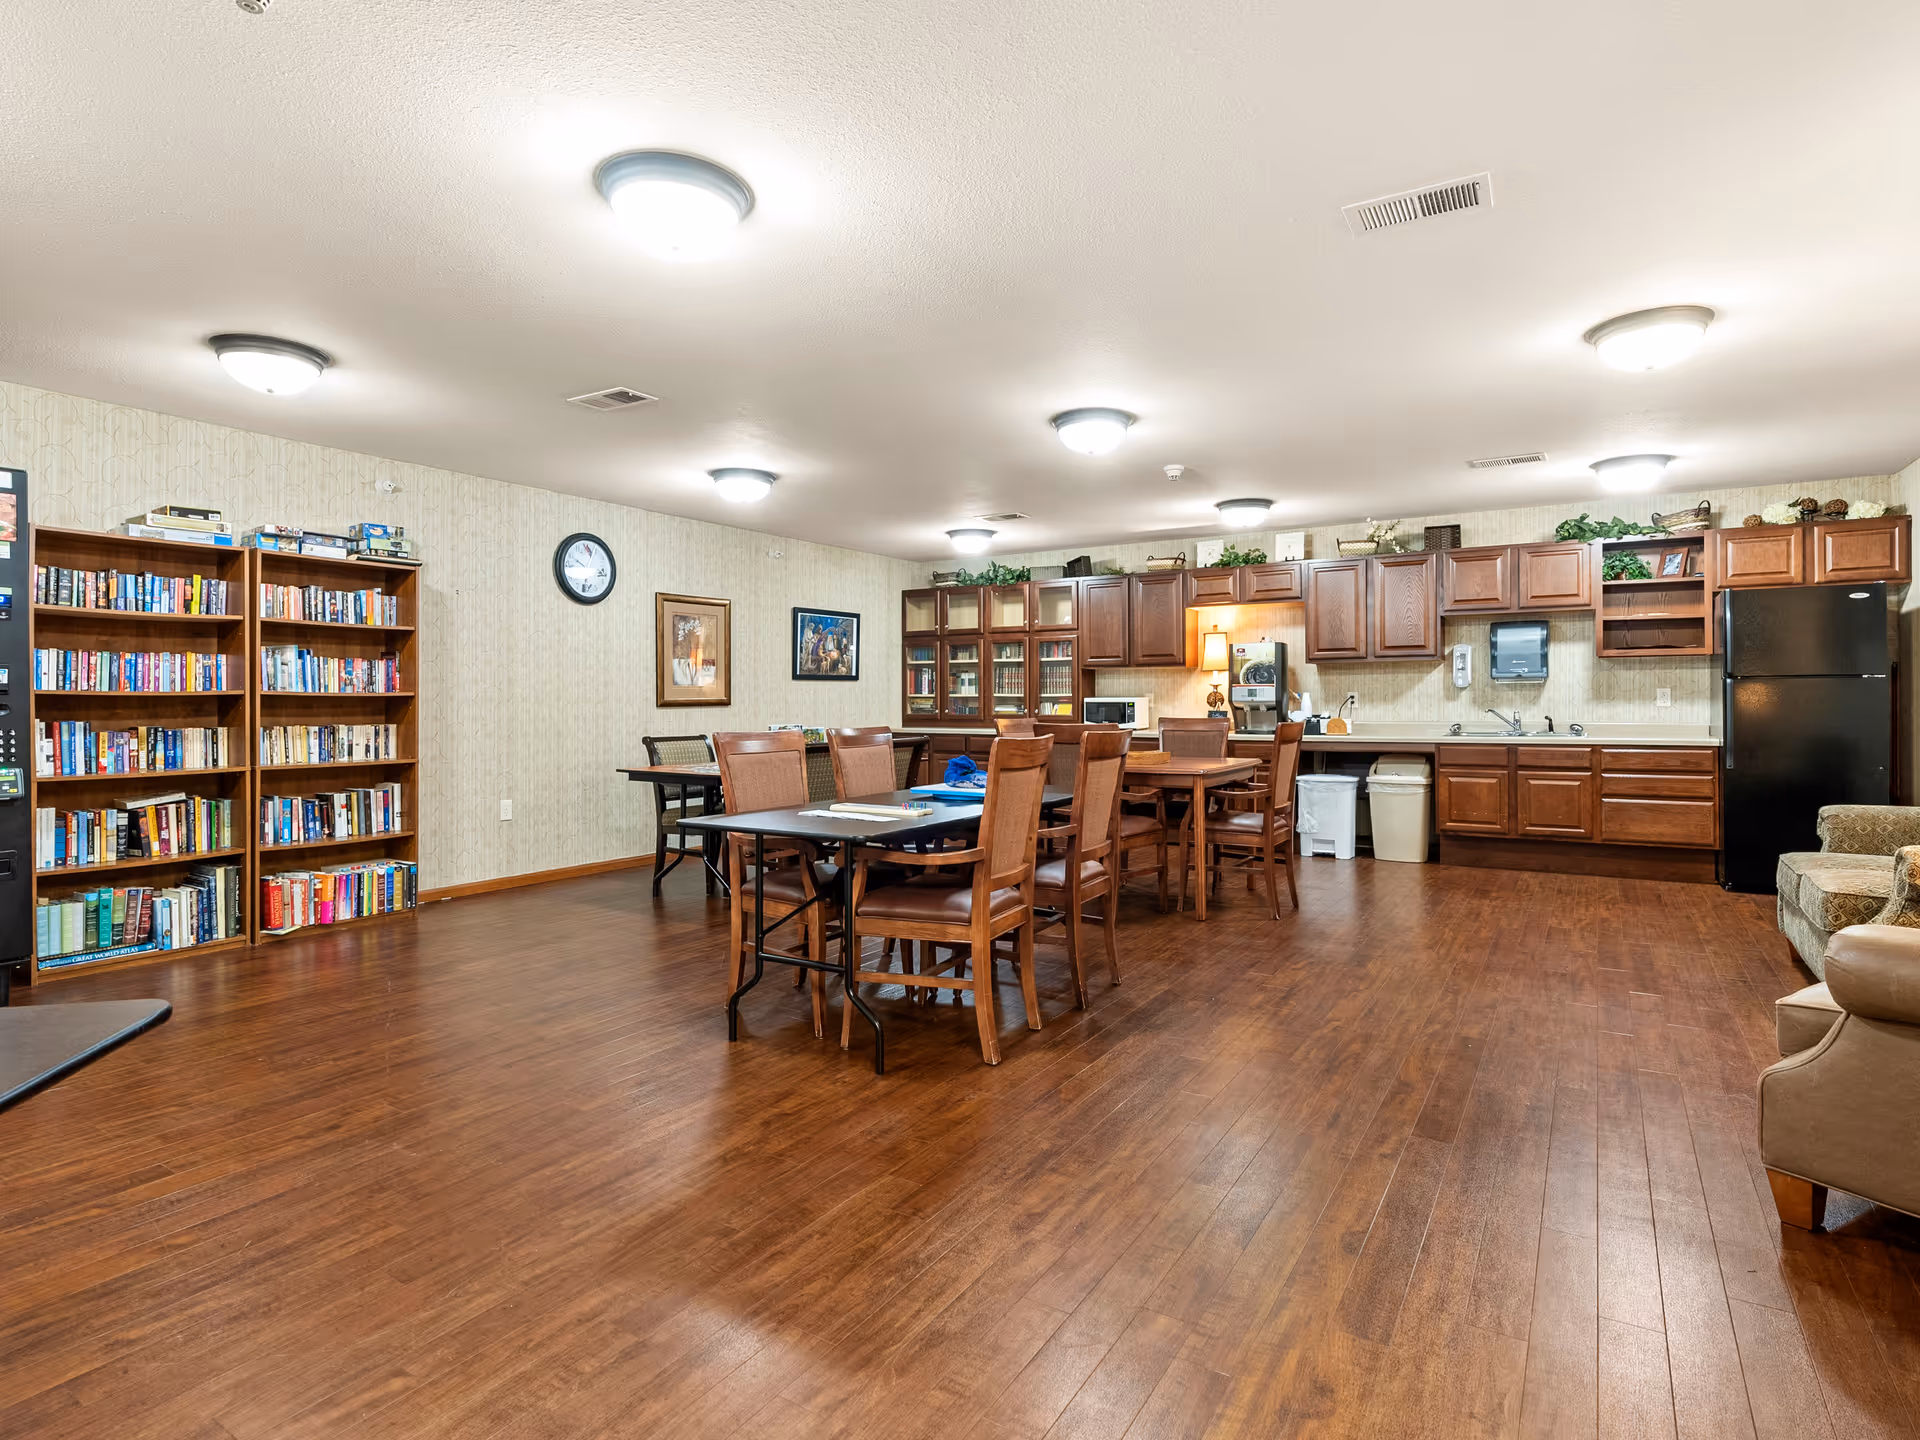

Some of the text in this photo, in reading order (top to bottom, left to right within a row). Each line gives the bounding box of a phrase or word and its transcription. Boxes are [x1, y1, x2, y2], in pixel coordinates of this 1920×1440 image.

[71, 953, 94, 963] GREAT
[94, 949, 120, 960] WORLD
[119, 946, 139, 957] ATLAS
